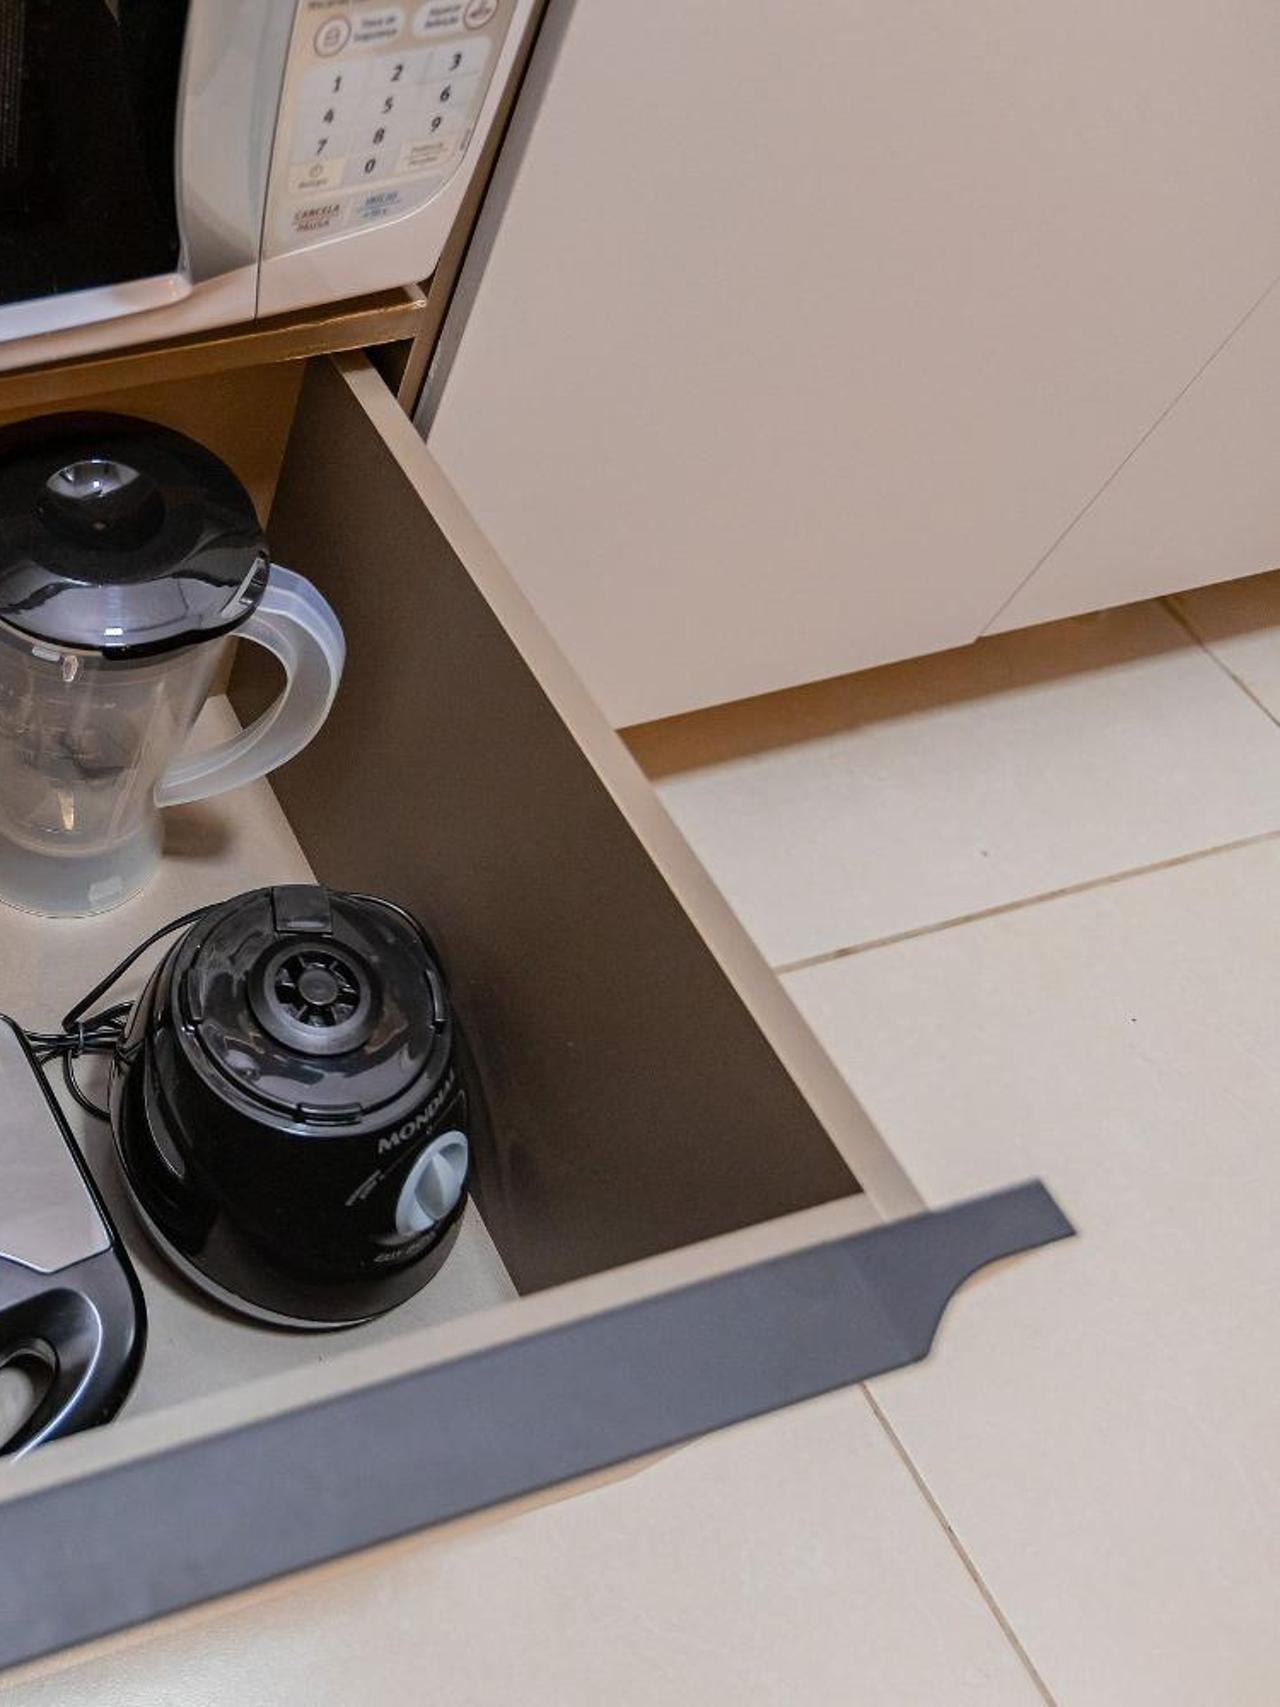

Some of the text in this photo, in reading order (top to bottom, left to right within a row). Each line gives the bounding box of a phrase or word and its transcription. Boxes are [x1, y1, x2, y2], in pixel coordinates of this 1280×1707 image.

[332, 53, 462, 93] 1 2 3
[382, 97, 393, 114] 5
[440, 85, 450, 102] 6
[316, 116, 442, 155] 7 8 9
[364, 158, 376, 174] 0
